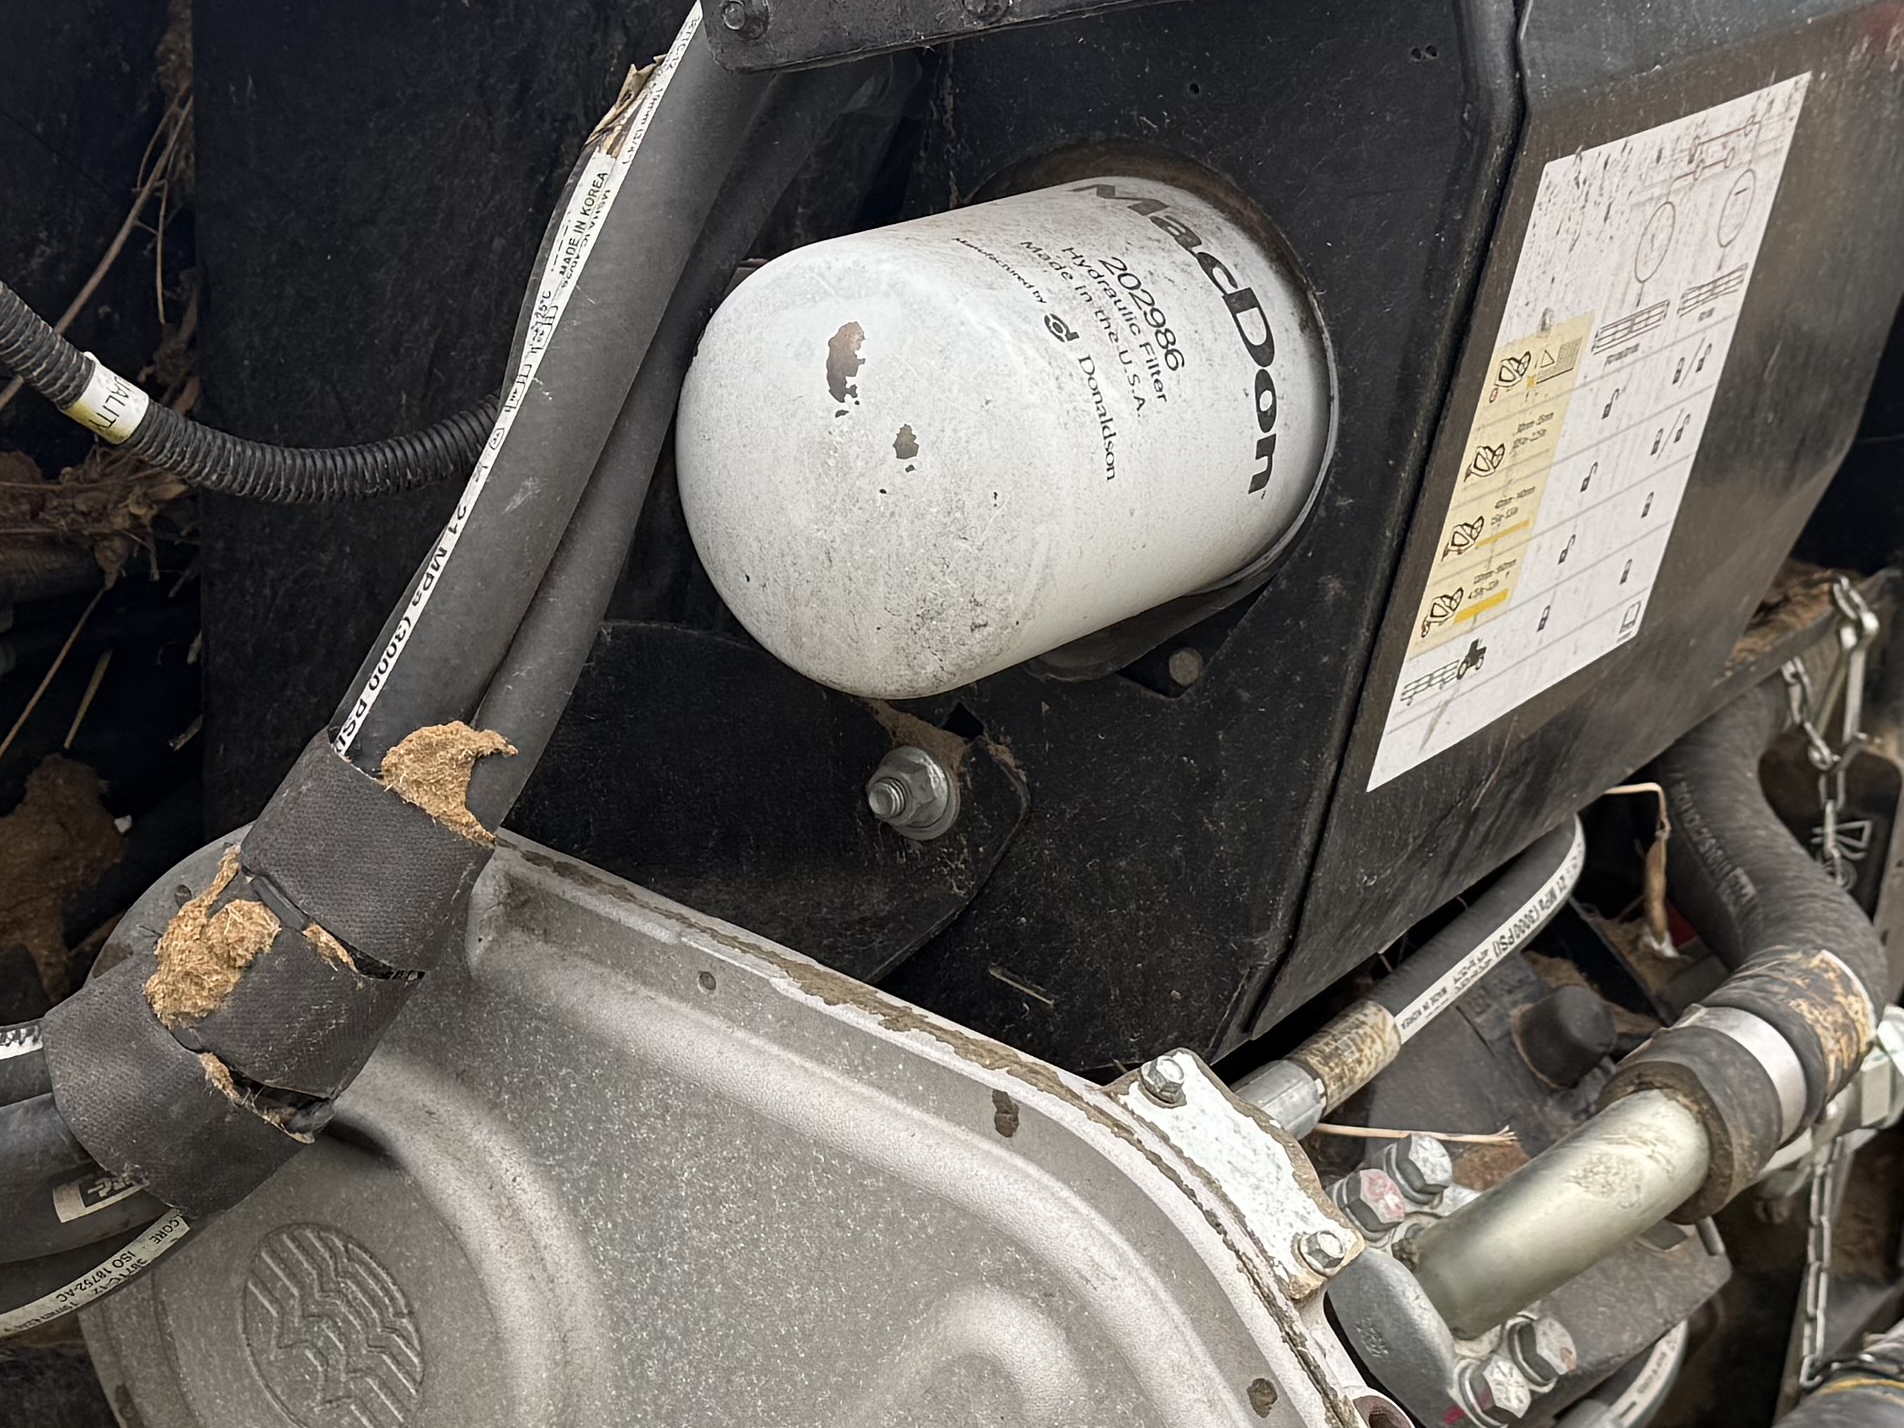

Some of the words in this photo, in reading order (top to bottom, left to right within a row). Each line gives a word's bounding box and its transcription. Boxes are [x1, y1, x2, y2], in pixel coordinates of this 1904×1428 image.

[580, 172, 608, 216] KOREA
[1020, 241, 1072, 282] Made
[1075, 284, 1092, 303] in
[1094, 310, 1119, 345] the
[1117, 349, 1148, 418] U.S.A.
[1061, 247, 1142, 336] Hydraulic
[1138, 341, 1167, 403] Filter
[1070, 183, 1277, 494] MacDon
[1099, 256, 1185, 372] 202986
[1078, 354, 1116, 481] Donaldson
